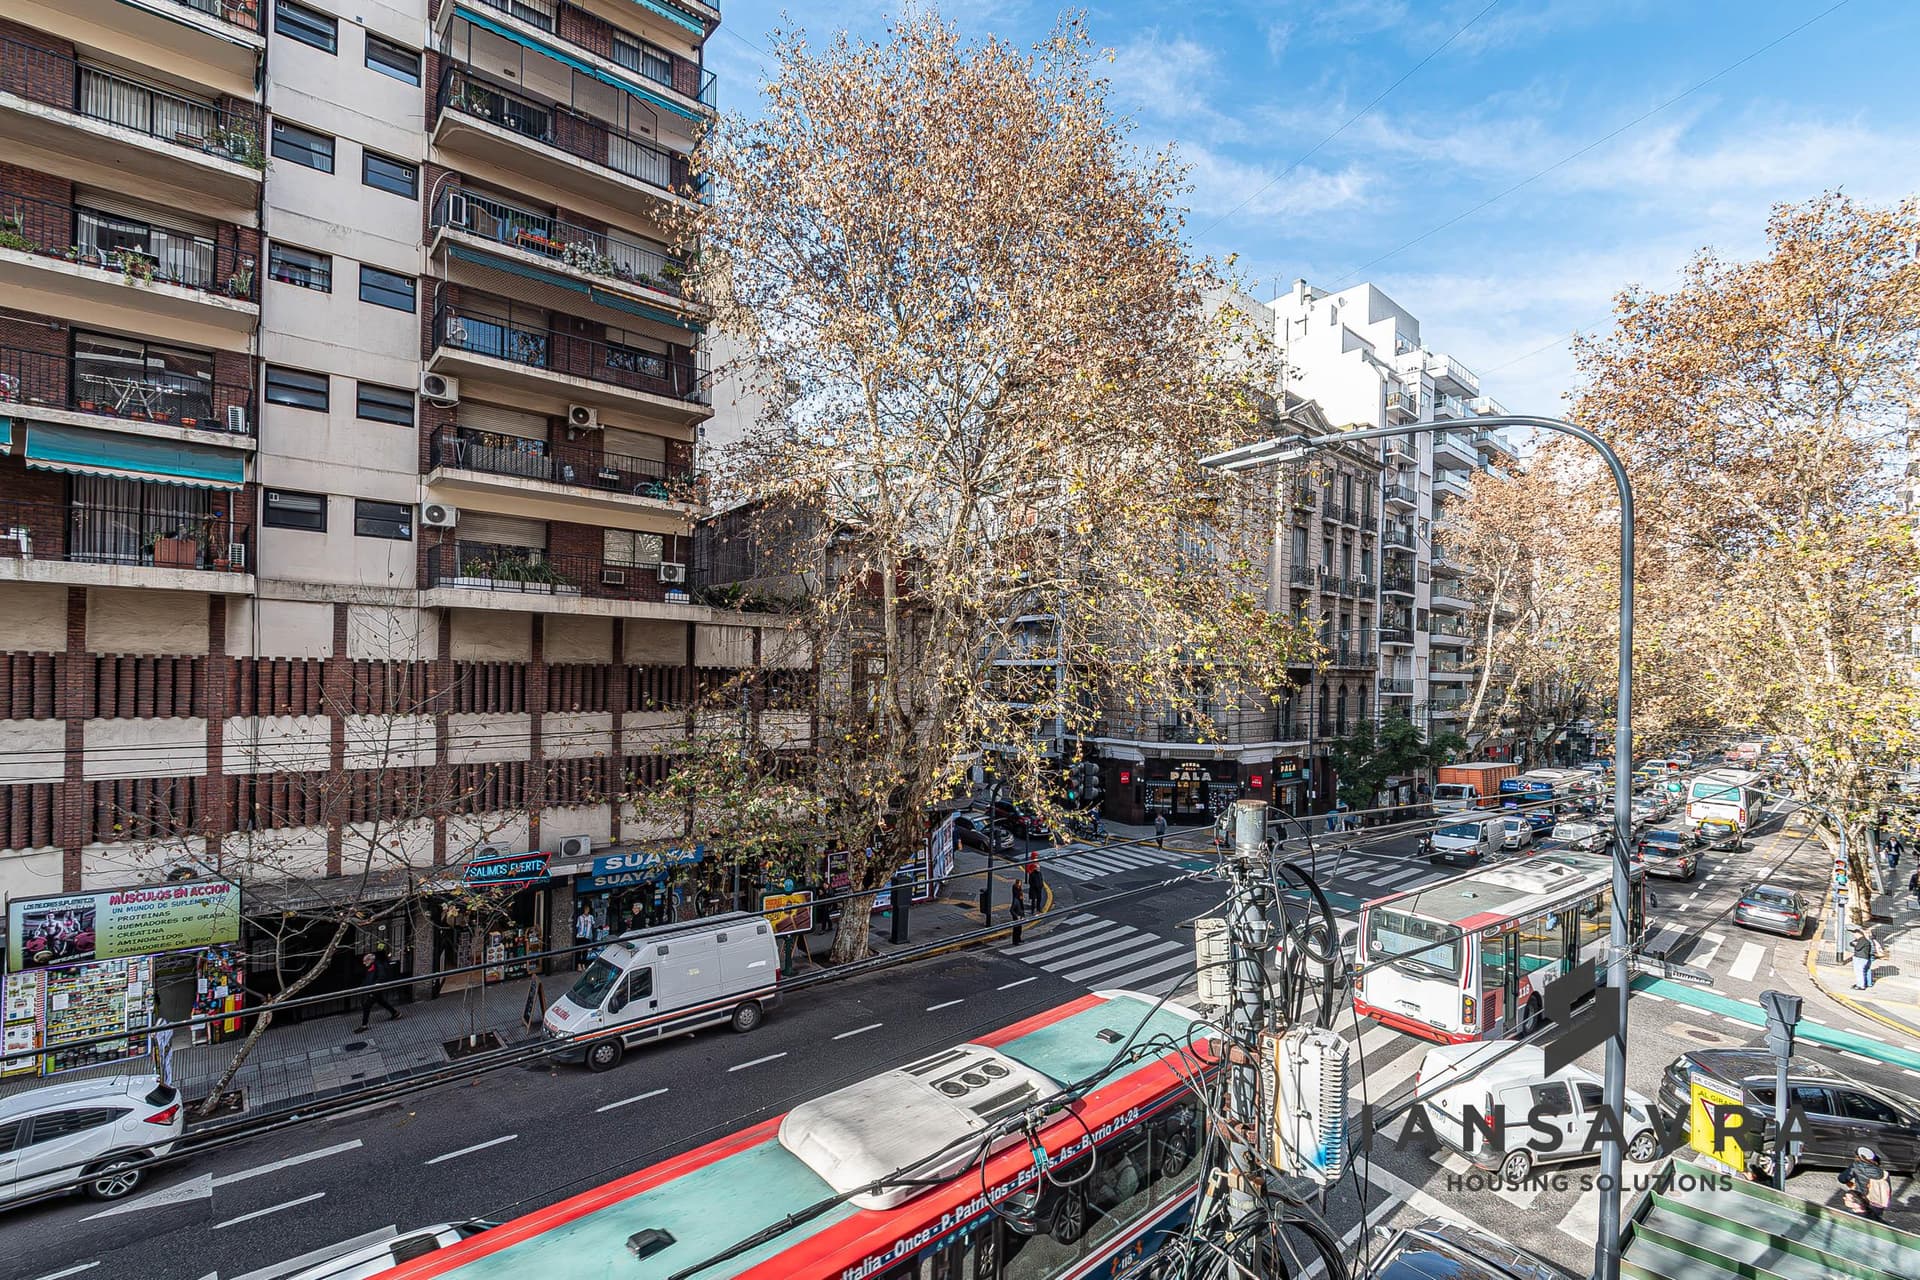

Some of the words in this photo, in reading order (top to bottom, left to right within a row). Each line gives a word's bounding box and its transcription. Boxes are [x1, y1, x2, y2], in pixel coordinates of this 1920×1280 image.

[1170, 771, 1212, 782] PALA
[469, 864, 508, 877] SALIMOS
[126, 904, 155, 912] MUNDO
[157, 901, 169, 909] DE
[171, 895, 227, 907] SUPLEMNTOS
[117, 911, 171, 922] PROTEINAS
[117, 918, 179, 930] QUEMADORES
[182, 915, 194, 923] DE
[117, 927, 165, 938] CREATINA
[117, 933, 184, 947] AMINOACIDOS
[1698, 1090, 1708, 1099] AL
[1704, 1080, 1740, 1097] CONDUCTOR
[895, 1228, 930, 1258] Once
